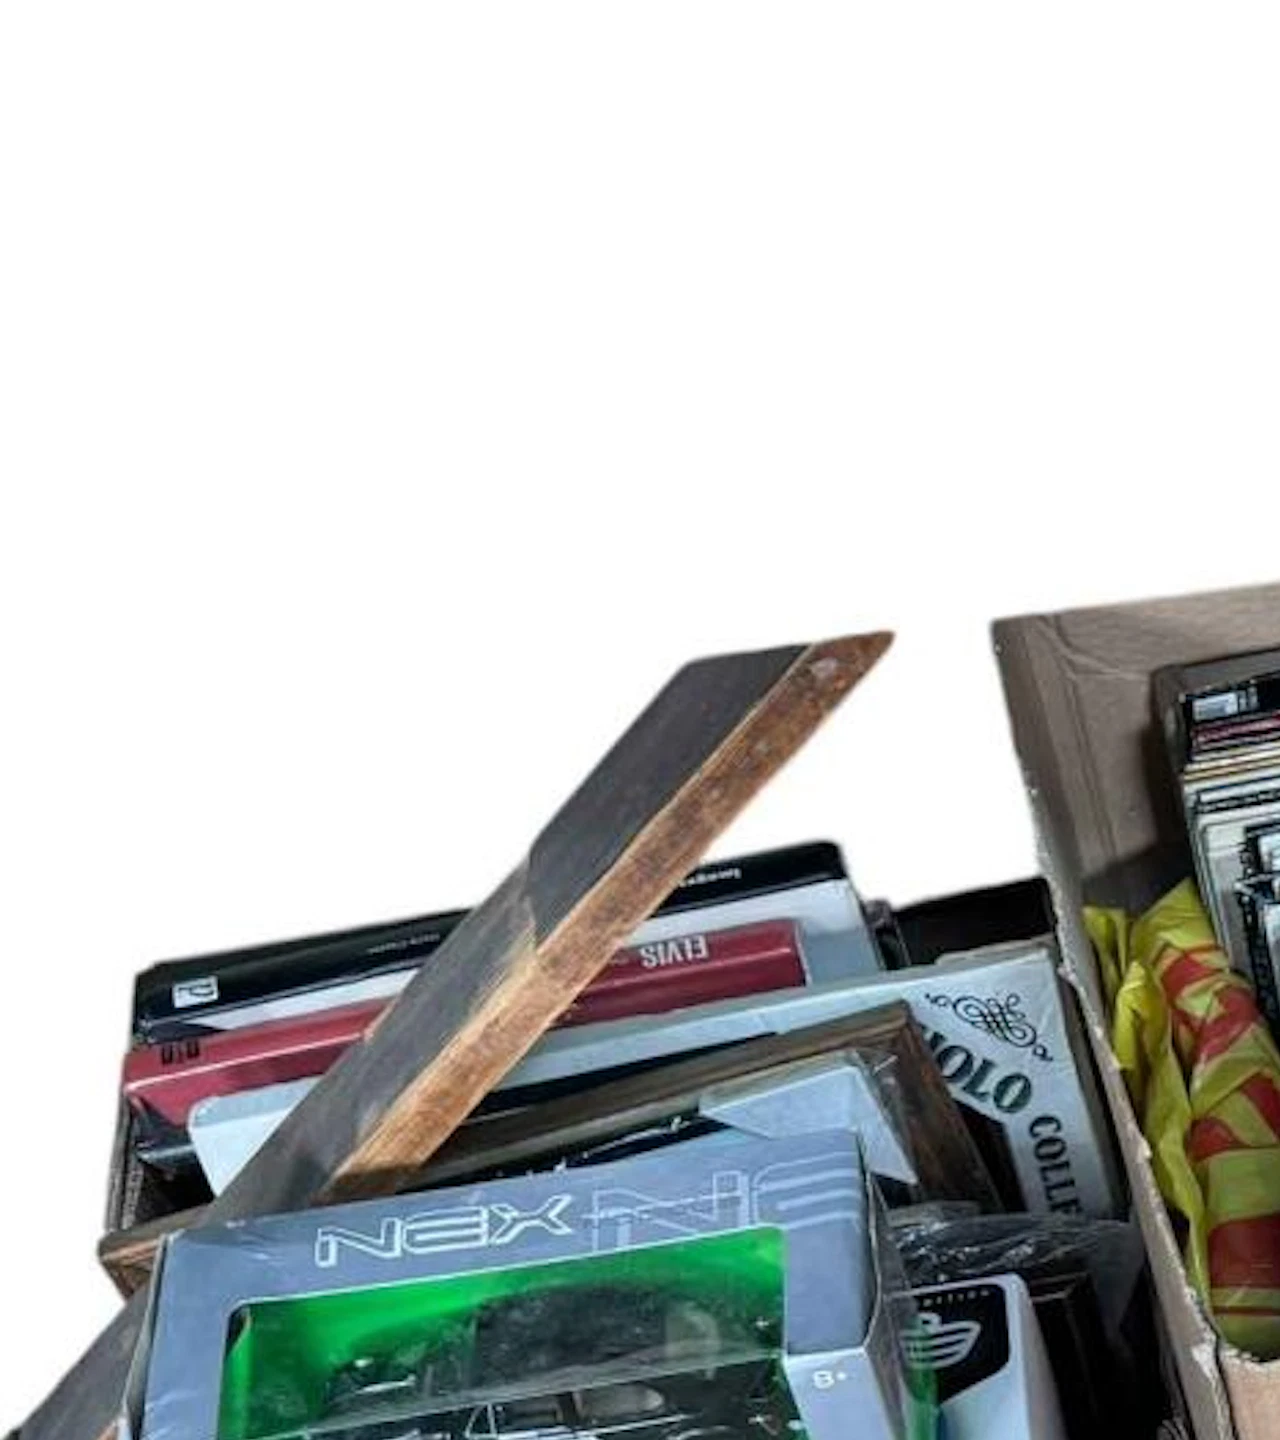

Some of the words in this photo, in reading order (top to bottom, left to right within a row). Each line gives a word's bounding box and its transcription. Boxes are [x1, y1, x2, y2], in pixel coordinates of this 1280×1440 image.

[639, 934, 710, 969] ELVIS
[918, 1021, 1033, 1114] OLO
[313, 1192, 575, 1268] NEX
